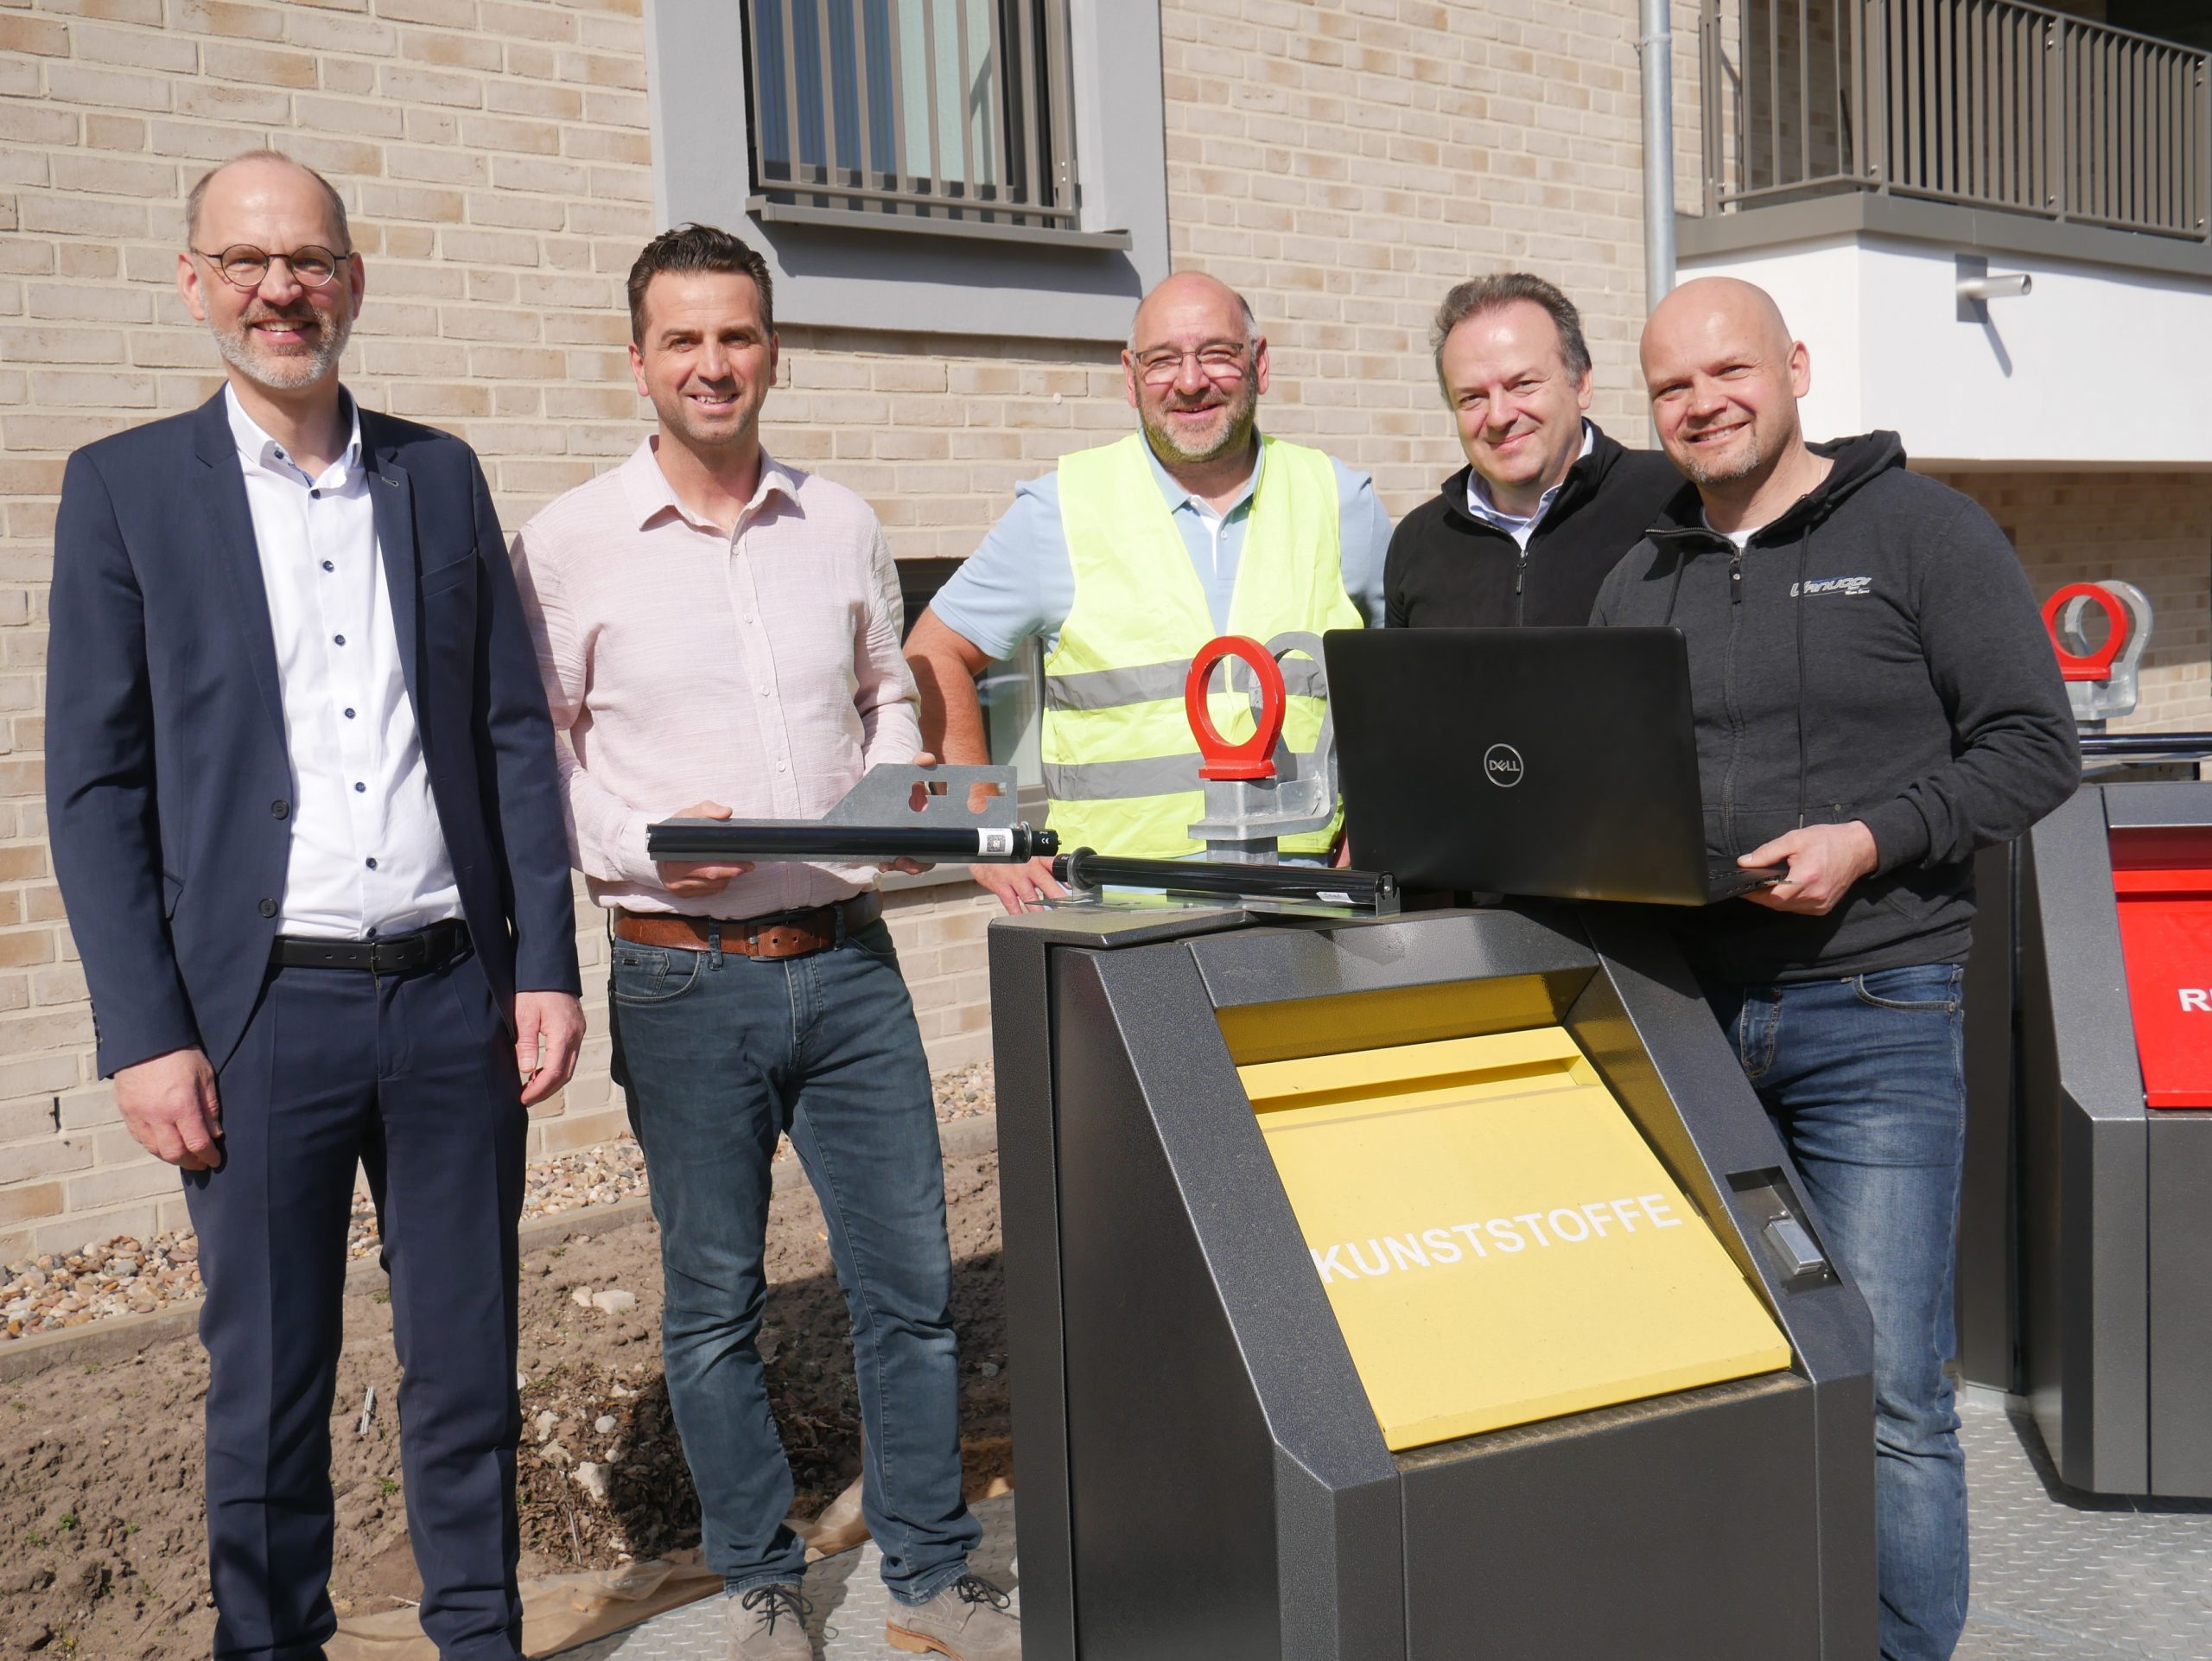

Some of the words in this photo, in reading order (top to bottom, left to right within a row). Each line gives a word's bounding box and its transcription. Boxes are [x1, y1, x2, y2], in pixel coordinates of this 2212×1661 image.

[1489, 760, 1520, 772] DELL
[2177, 988, 2212, 1012] R
[1310, 1193, 1682, 1283] KUNSTSTOFFE
